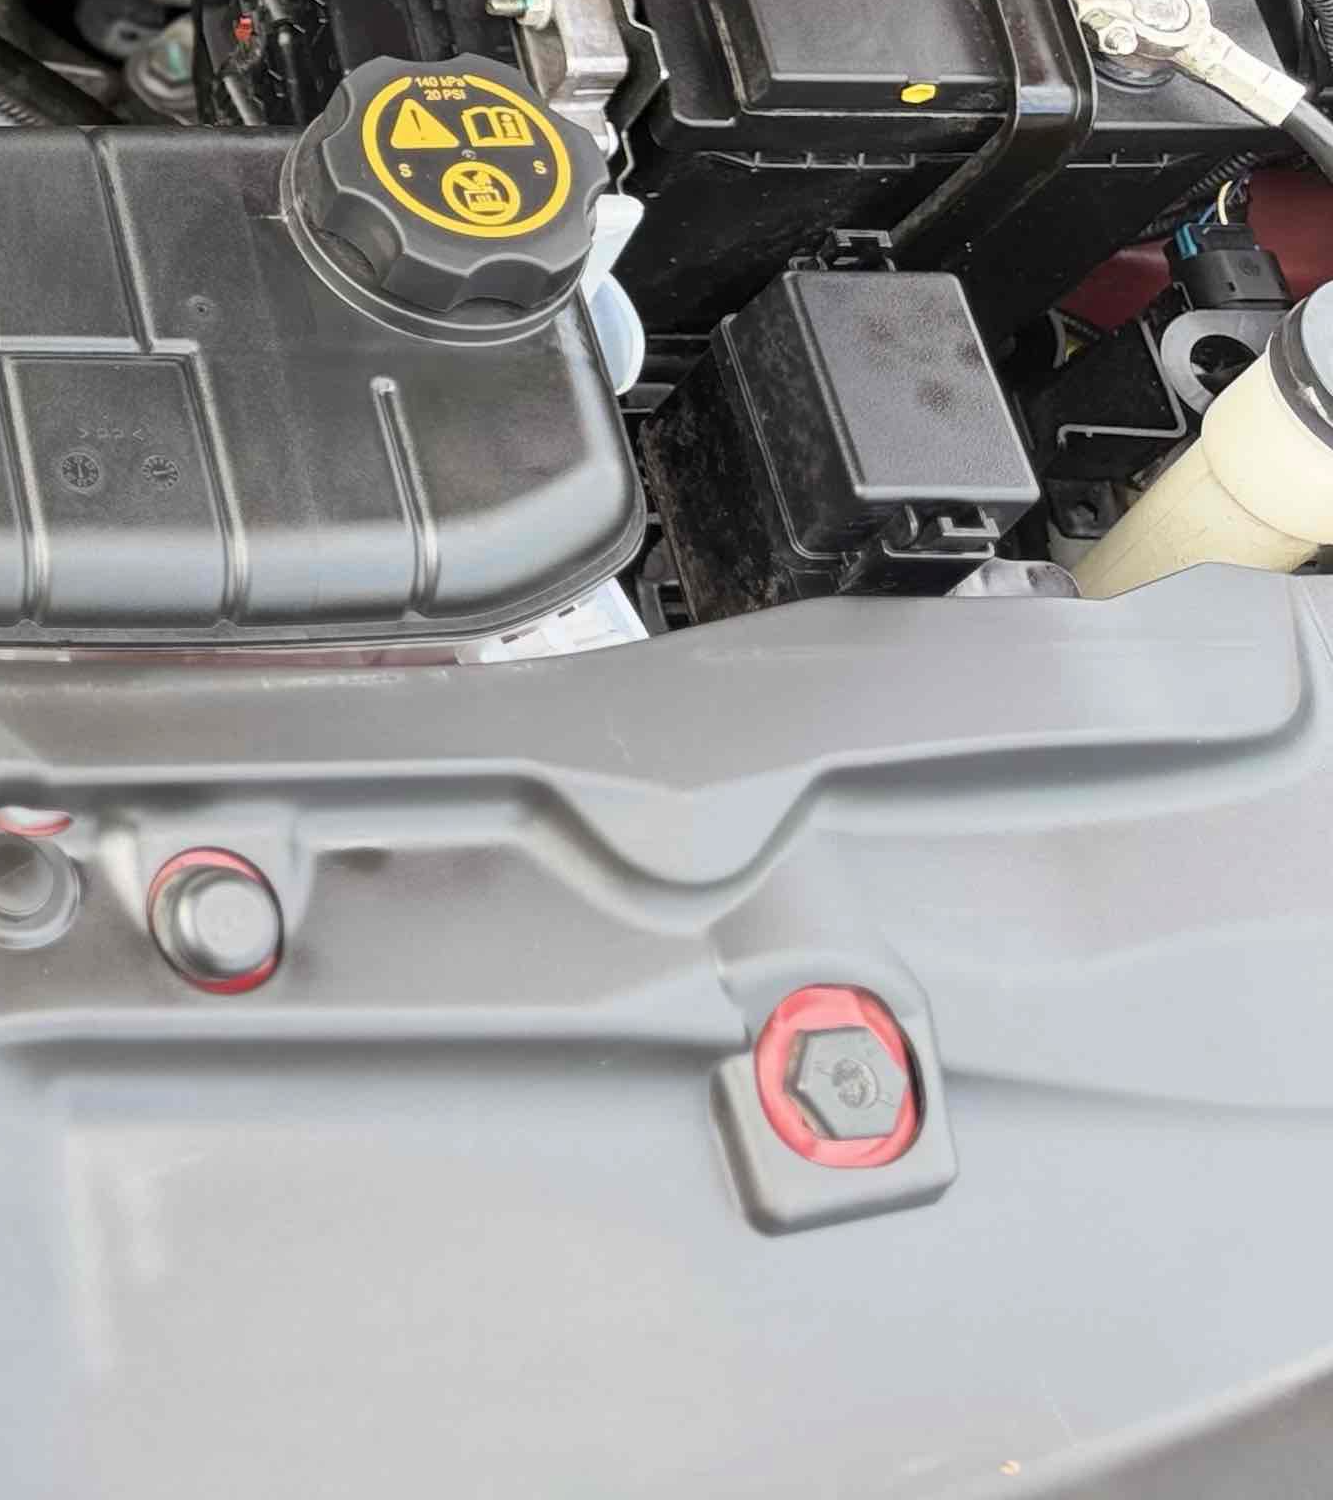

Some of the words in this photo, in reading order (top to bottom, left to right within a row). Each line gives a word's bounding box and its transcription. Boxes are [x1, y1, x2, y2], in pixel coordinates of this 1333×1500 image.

[414, 76, 439, 88] 140
[423, 88, 441, 100] 20
[442, 88, 466, 100] PSI
